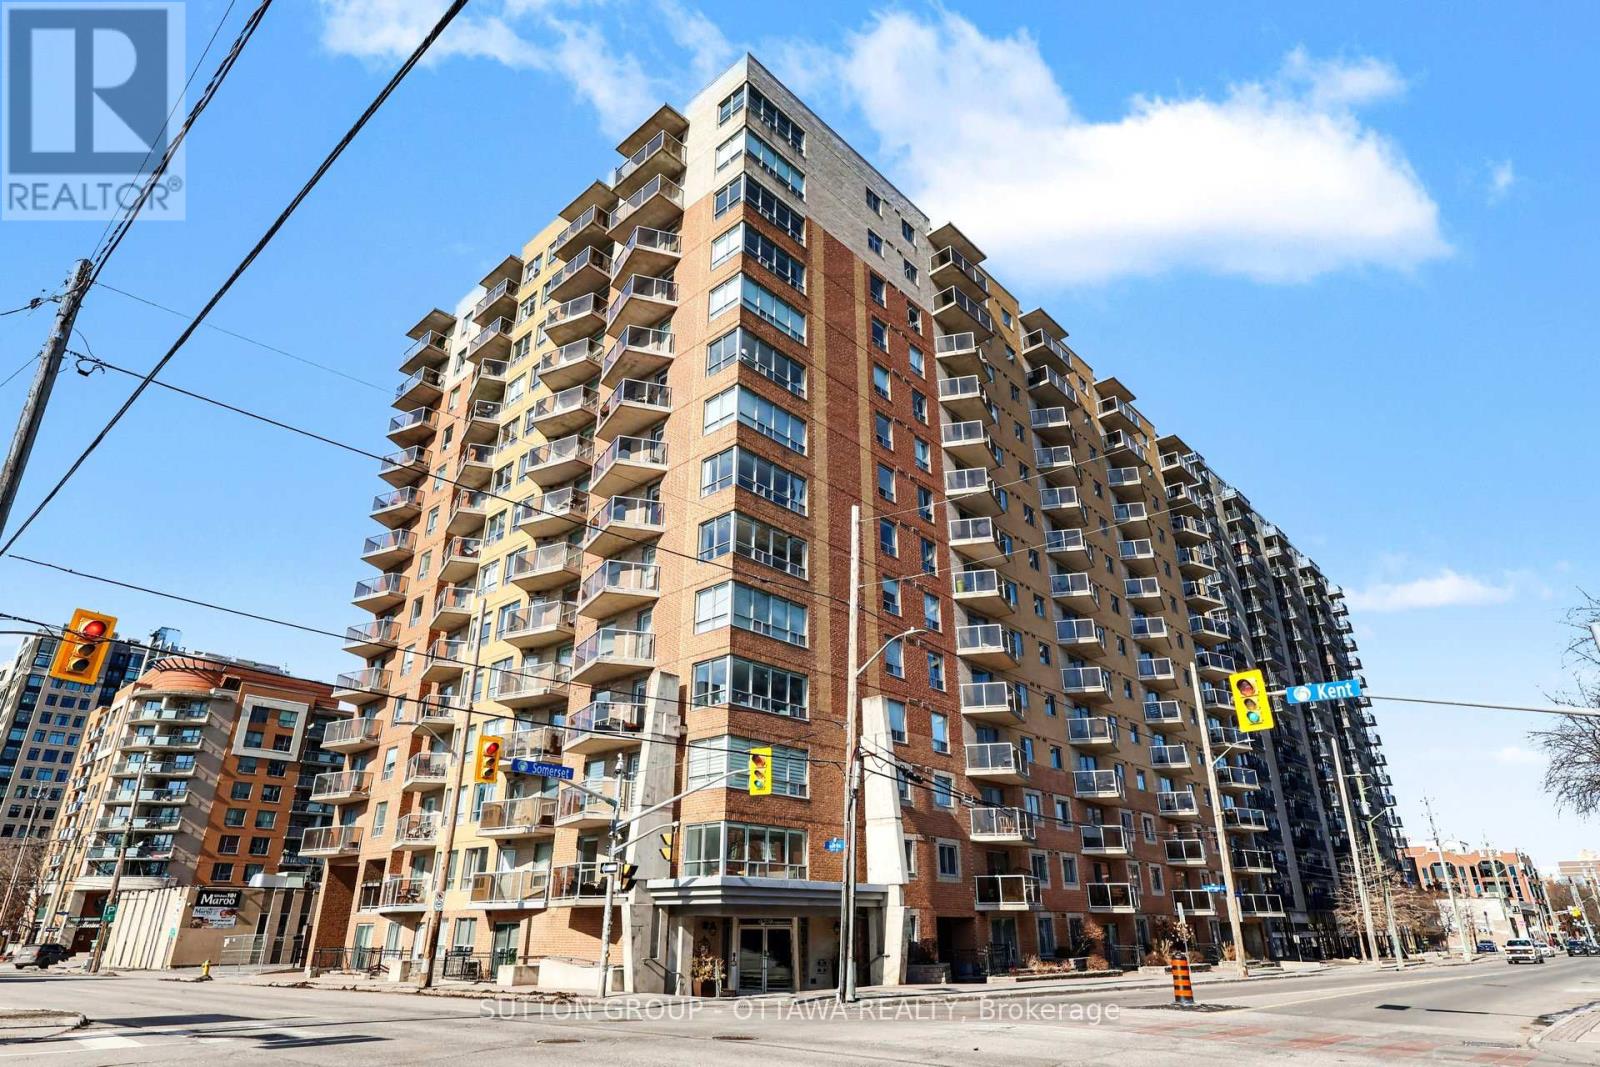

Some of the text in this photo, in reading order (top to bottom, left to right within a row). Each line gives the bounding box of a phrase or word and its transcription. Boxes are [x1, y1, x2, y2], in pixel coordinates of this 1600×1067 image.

[1317, 682, 1354, 700] Kent
[532, 763, 570, 779] Somerset
[200, 893, 236, 905] Maroo
